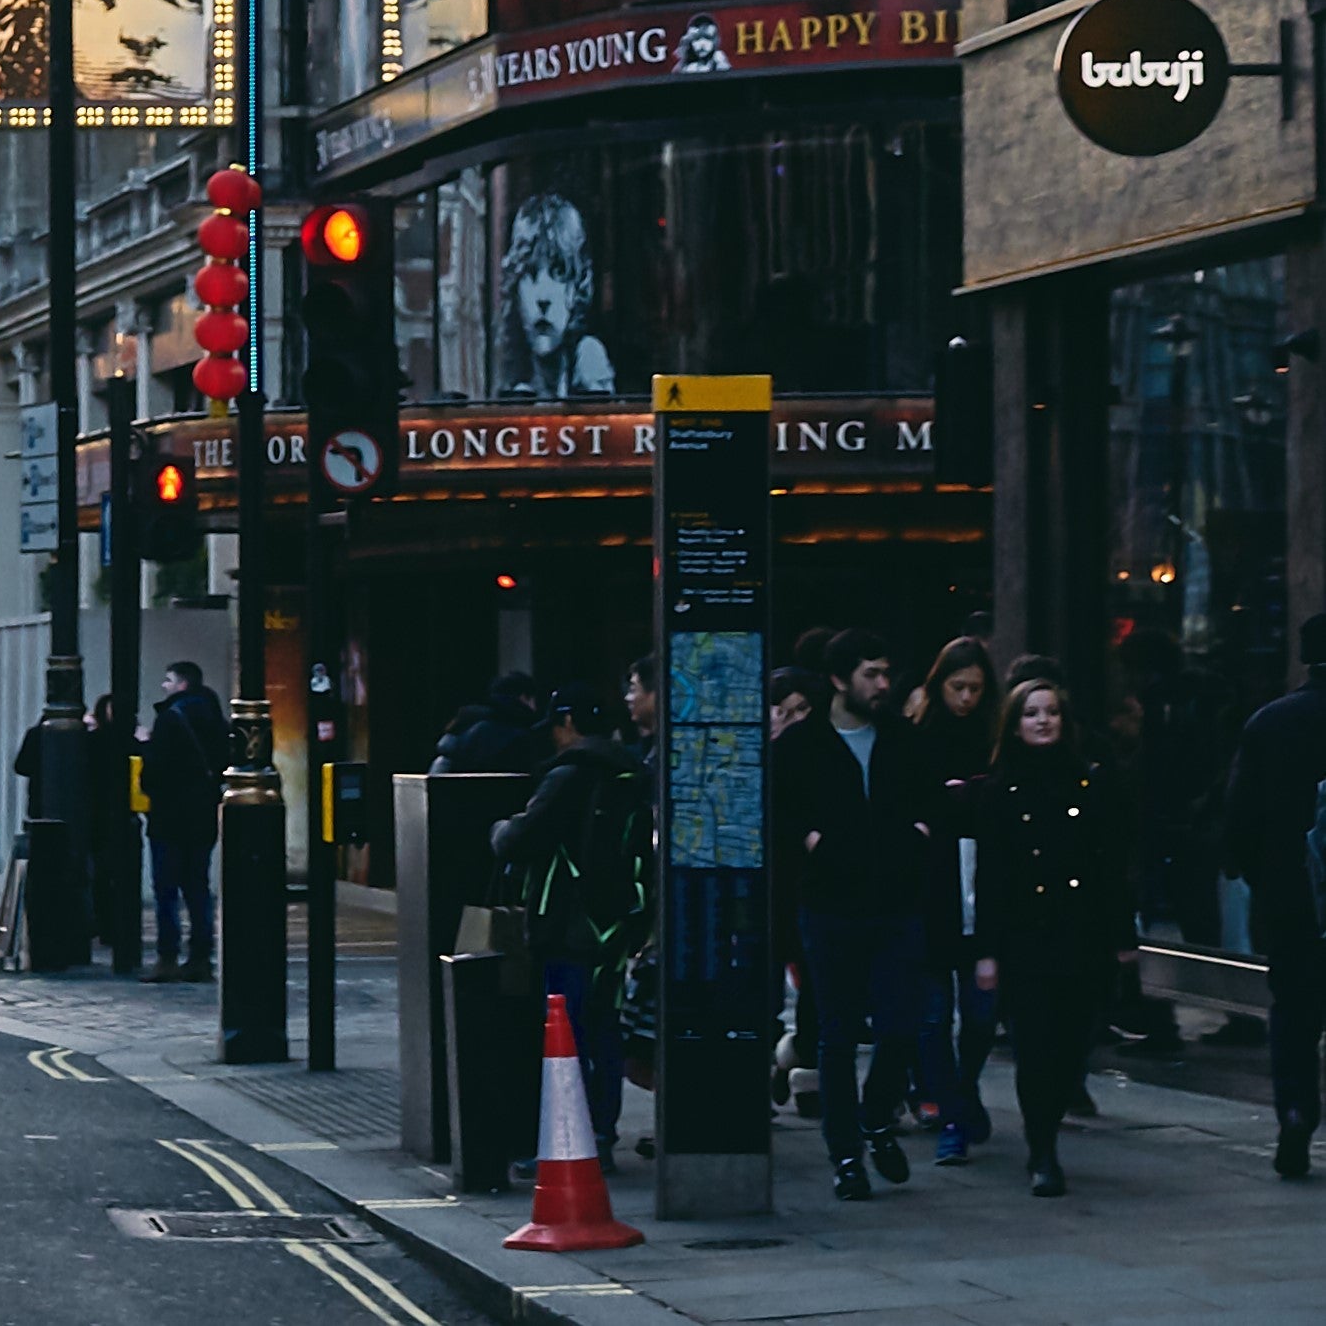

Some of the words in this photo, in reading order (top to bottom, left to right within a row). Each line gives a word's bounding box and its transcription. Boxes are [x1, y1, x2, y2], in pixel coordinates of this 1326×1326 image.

[495, 45, 562, 87] YEARS
[564, 27, 668, 74] YOUNG
[736, 11, 876, 55] HAPPY
[899, 10, 963, 45] BI
[193, 438, 233, 468] THE
[407, 425, 610, 459] LONGEST
